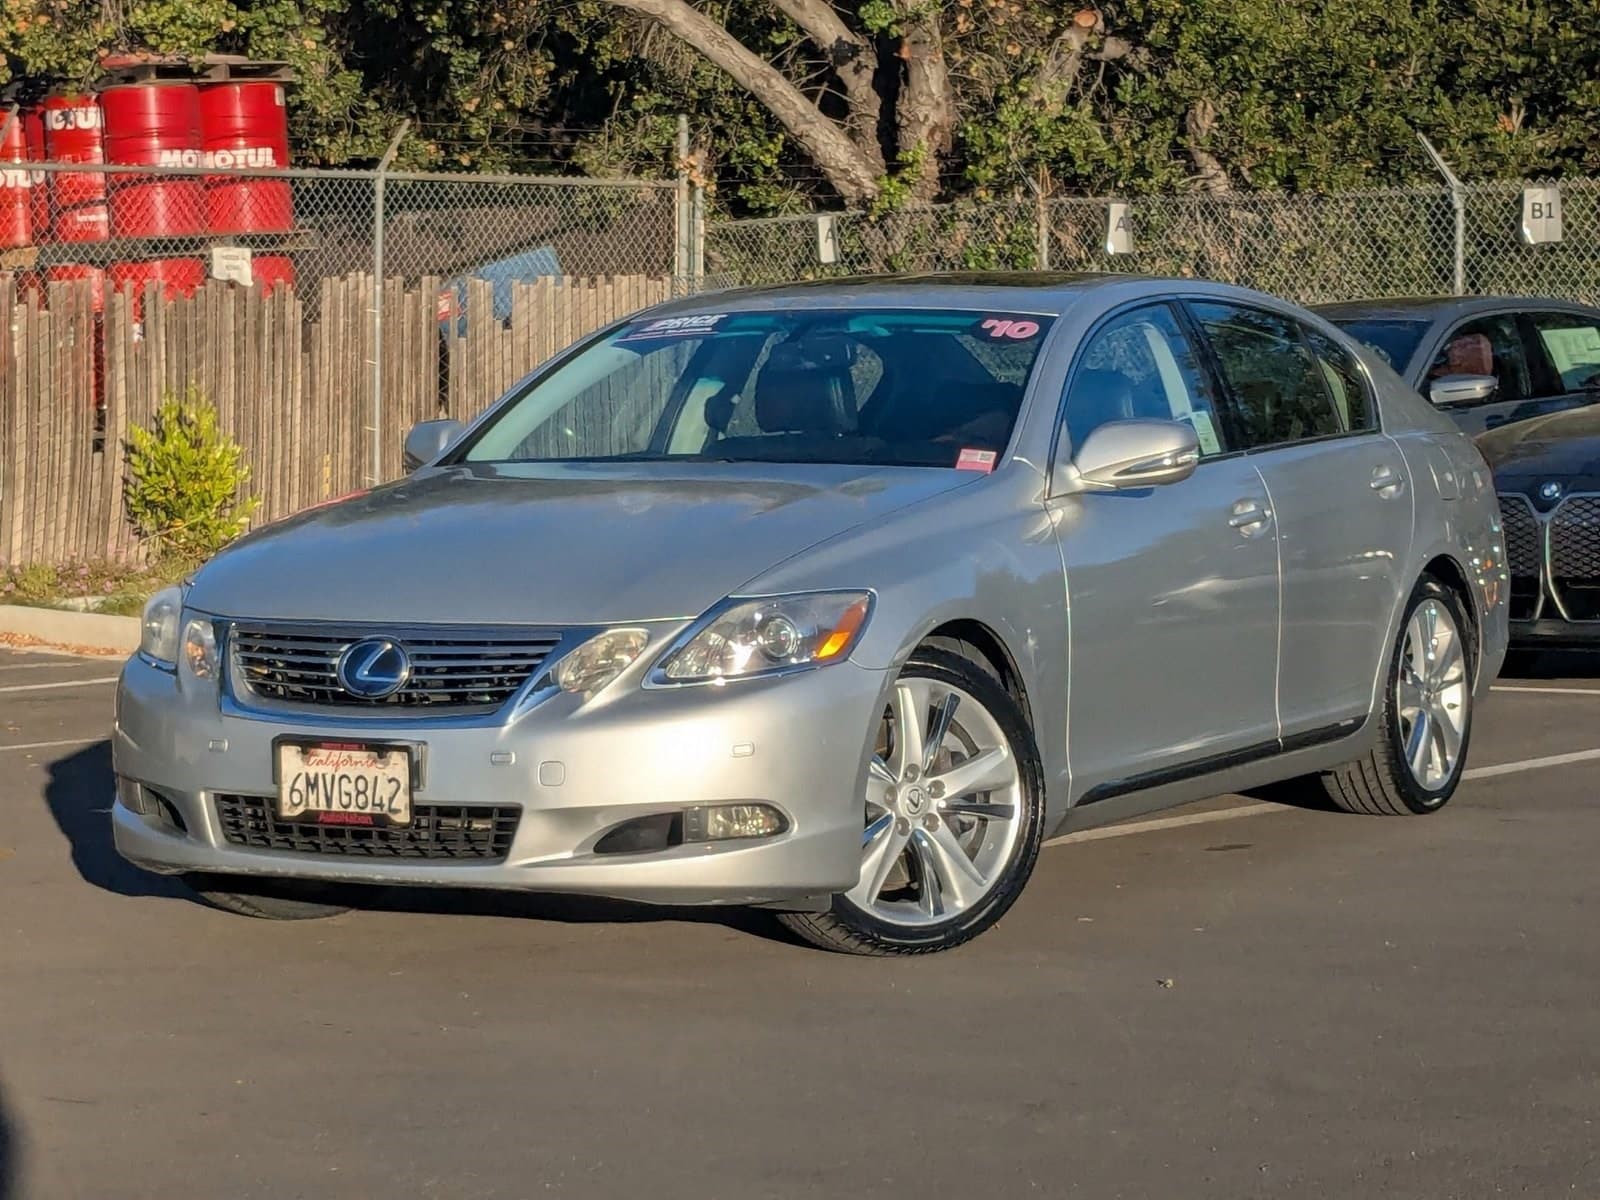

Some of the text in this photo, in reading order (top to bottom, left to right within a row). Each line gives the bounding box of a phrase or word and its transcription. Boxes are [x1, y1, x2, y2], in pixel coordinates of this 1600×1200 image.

[200, 147, 277, 169] MOTUL
[1531, 202, 1555, 219] B1
[305, 750, 378, 773] California
[289, 771, 402, 815] 6MVG842
